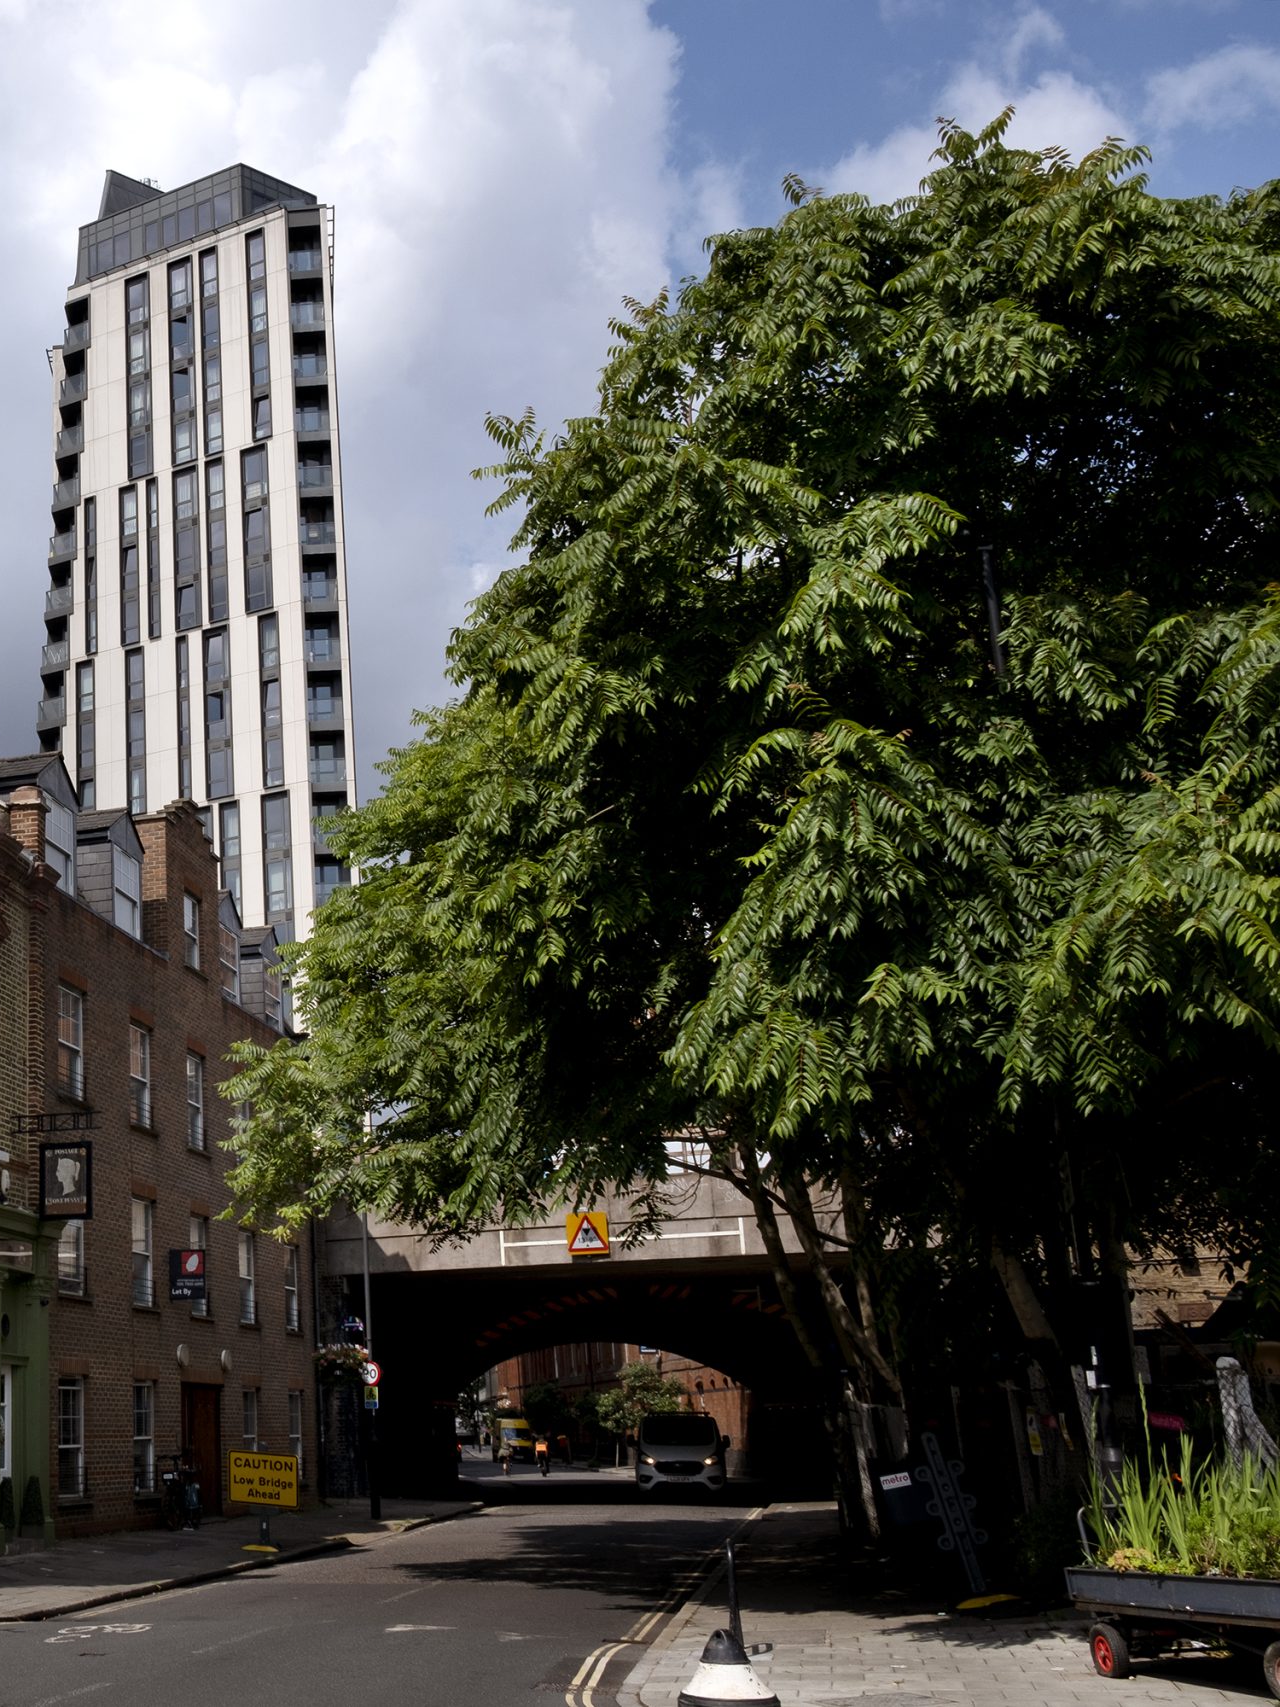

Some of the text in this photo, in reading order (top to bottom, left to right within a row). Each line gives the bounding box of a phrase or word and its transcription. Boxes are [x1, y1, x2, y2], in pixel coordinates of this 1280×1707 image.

[233, 1457, 293, 1472] CAUTION
[233, 1474, 294, 1490] Low Bridge
[882, 1474, 909, 1485] metro
[247, 1488, 281, 1500] Ahead
